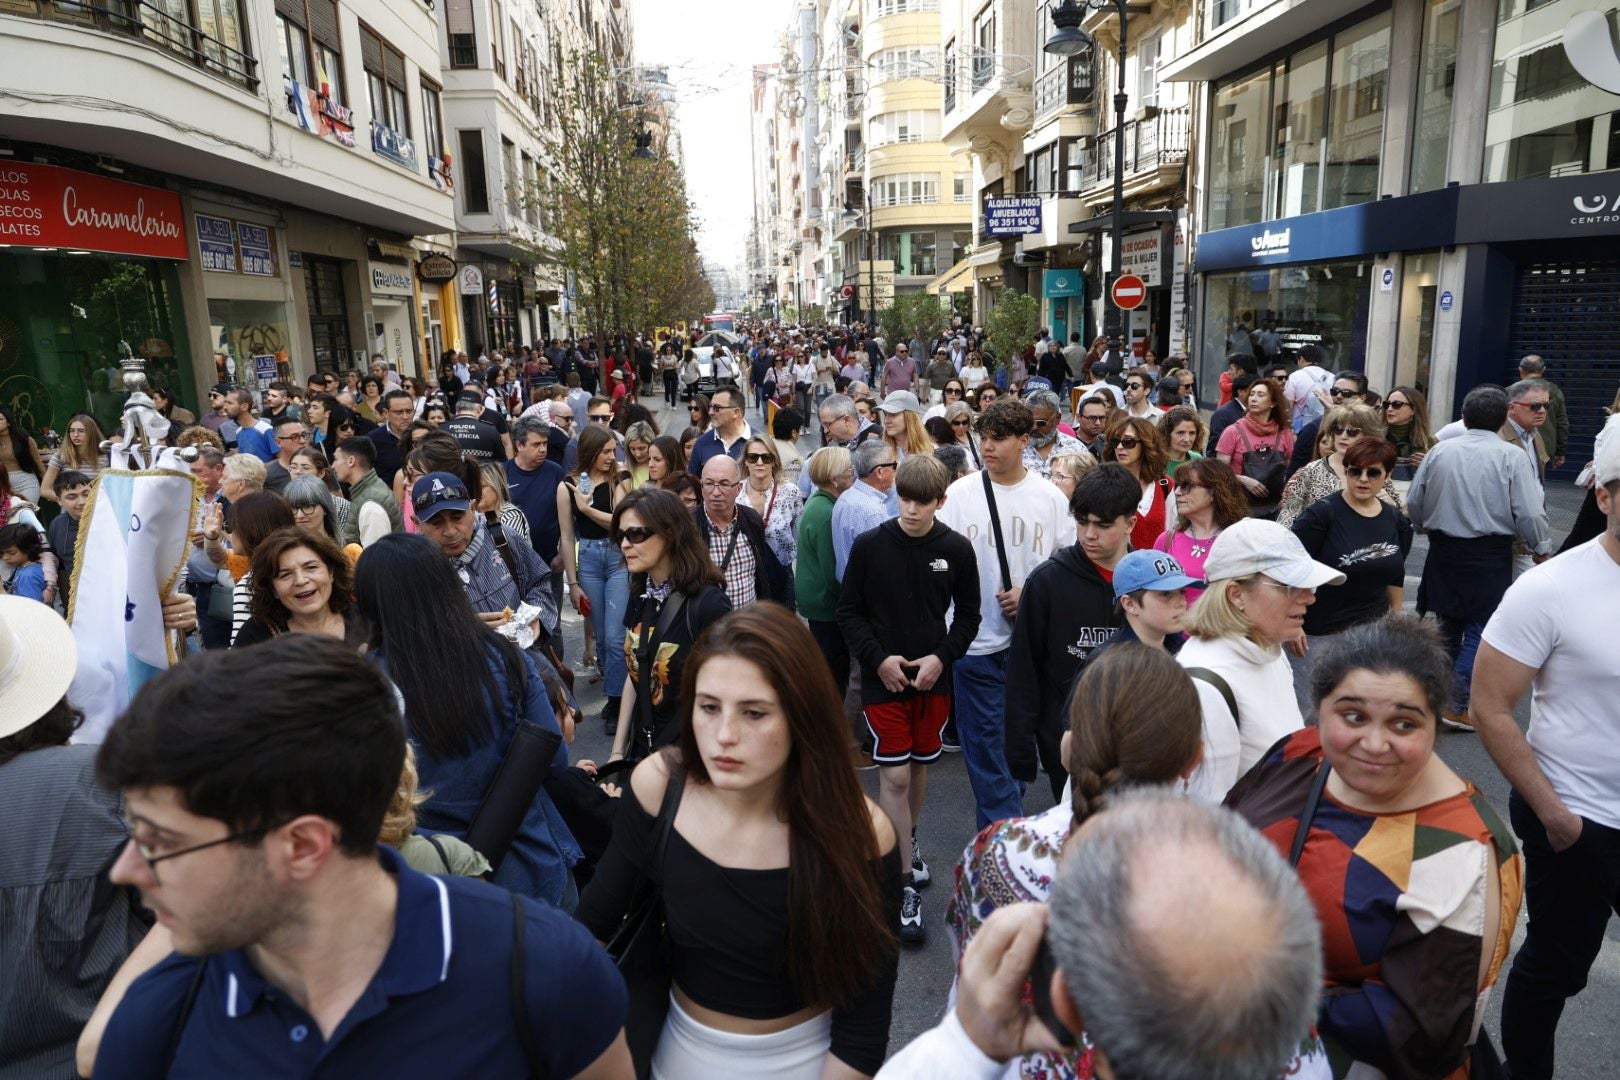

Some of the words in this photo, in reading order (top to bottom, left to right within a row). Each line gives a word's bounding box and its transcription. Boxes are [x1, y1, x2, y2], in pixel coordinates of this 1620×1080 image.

[988, 199, 1020, 208] ALQUILER
[1021, 198, 1040, 207] PISOS
[992, 209, 1036, 218] AMUEBLADOS
[988, 219, 999, 227] 96
[1001, 218, 1015, 227] 351
[1017, 218, 1028, 226] 94
[1030, 217, 1040, 226] 08
[1570, 215, 1620, 225] CENTRO
[199, 219, 212, 235] LA
[213, 220, 229, 237] SEU
[240, 227, 252, 241] LA
[253, 228, 267, 243] SEU
